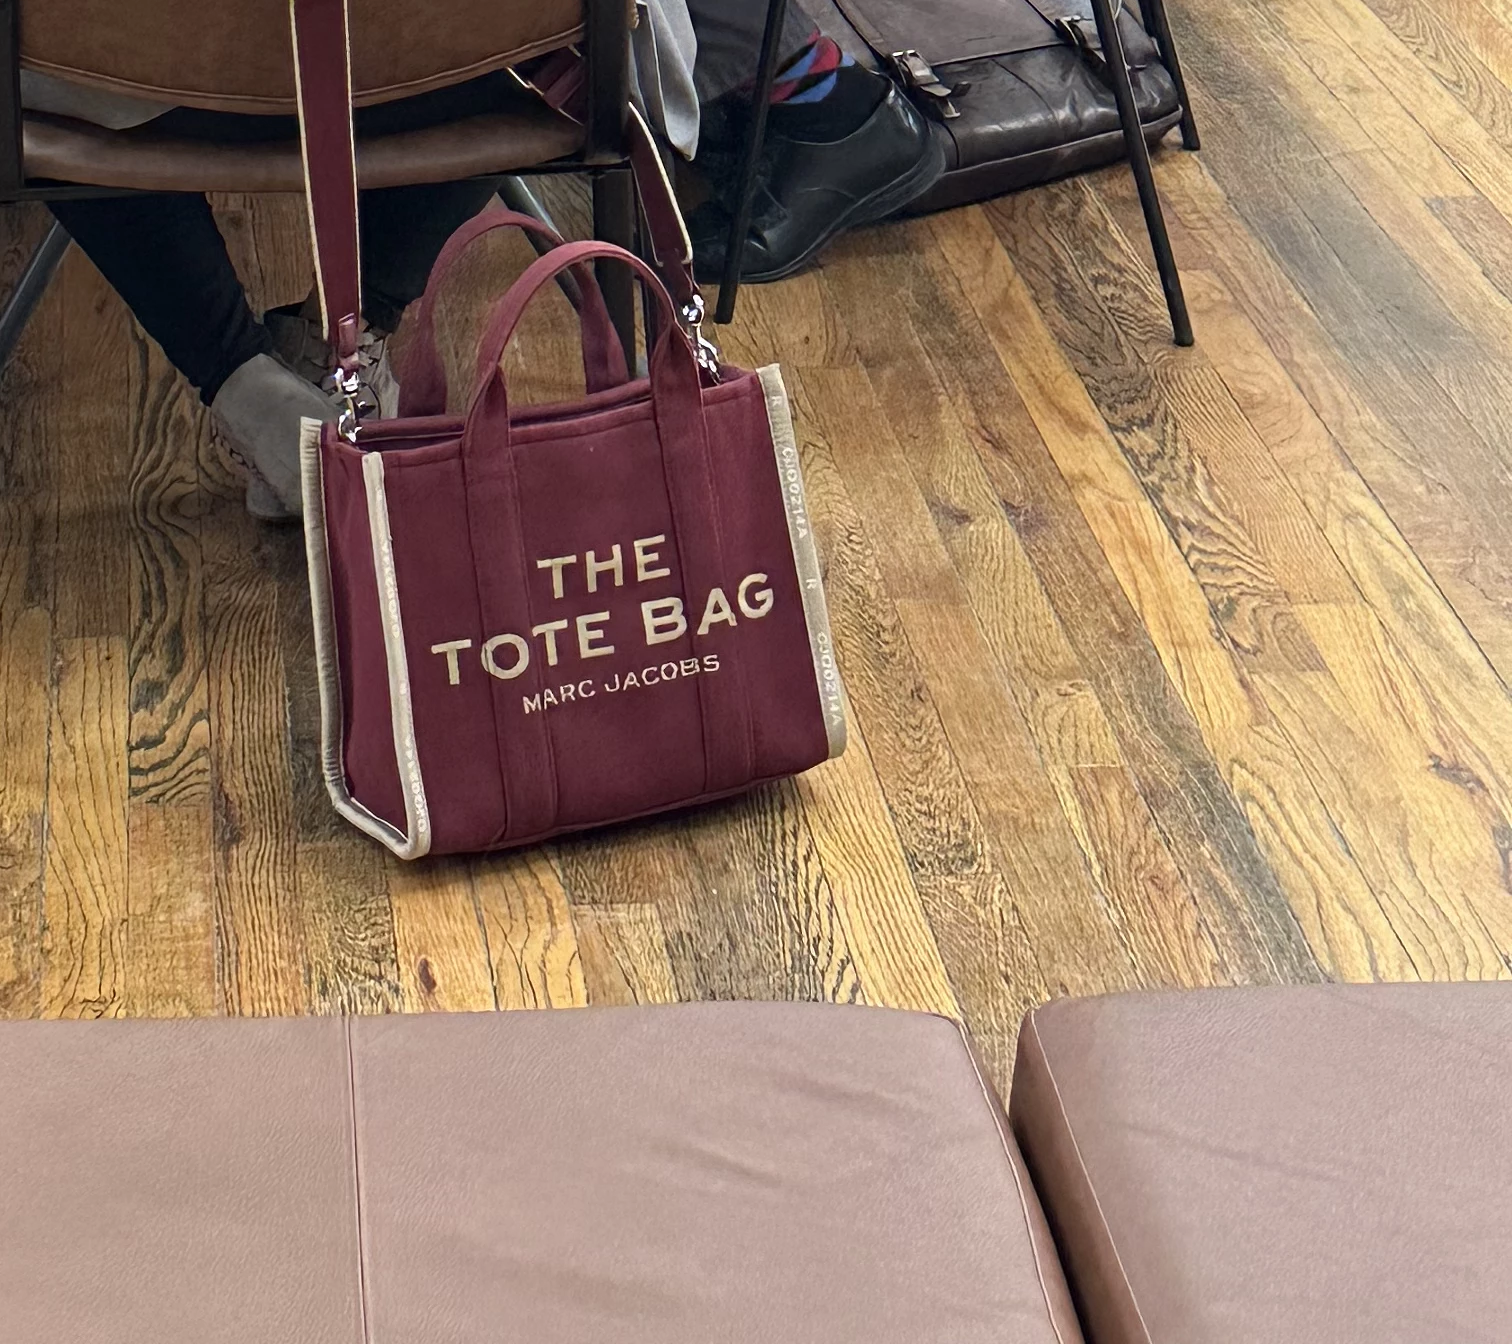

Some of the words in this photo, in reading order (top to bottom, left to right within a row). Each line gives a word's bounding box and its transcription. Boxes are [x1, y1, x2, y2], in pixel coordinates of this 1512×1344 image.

[537, 534, 670, 599] THE
[431, 611, 615, 686] TOTE
[640, 573, 774, 646] BAG
[522, 678, 596, 715] MARC
[604, 654, 721, 694] JACOBS
